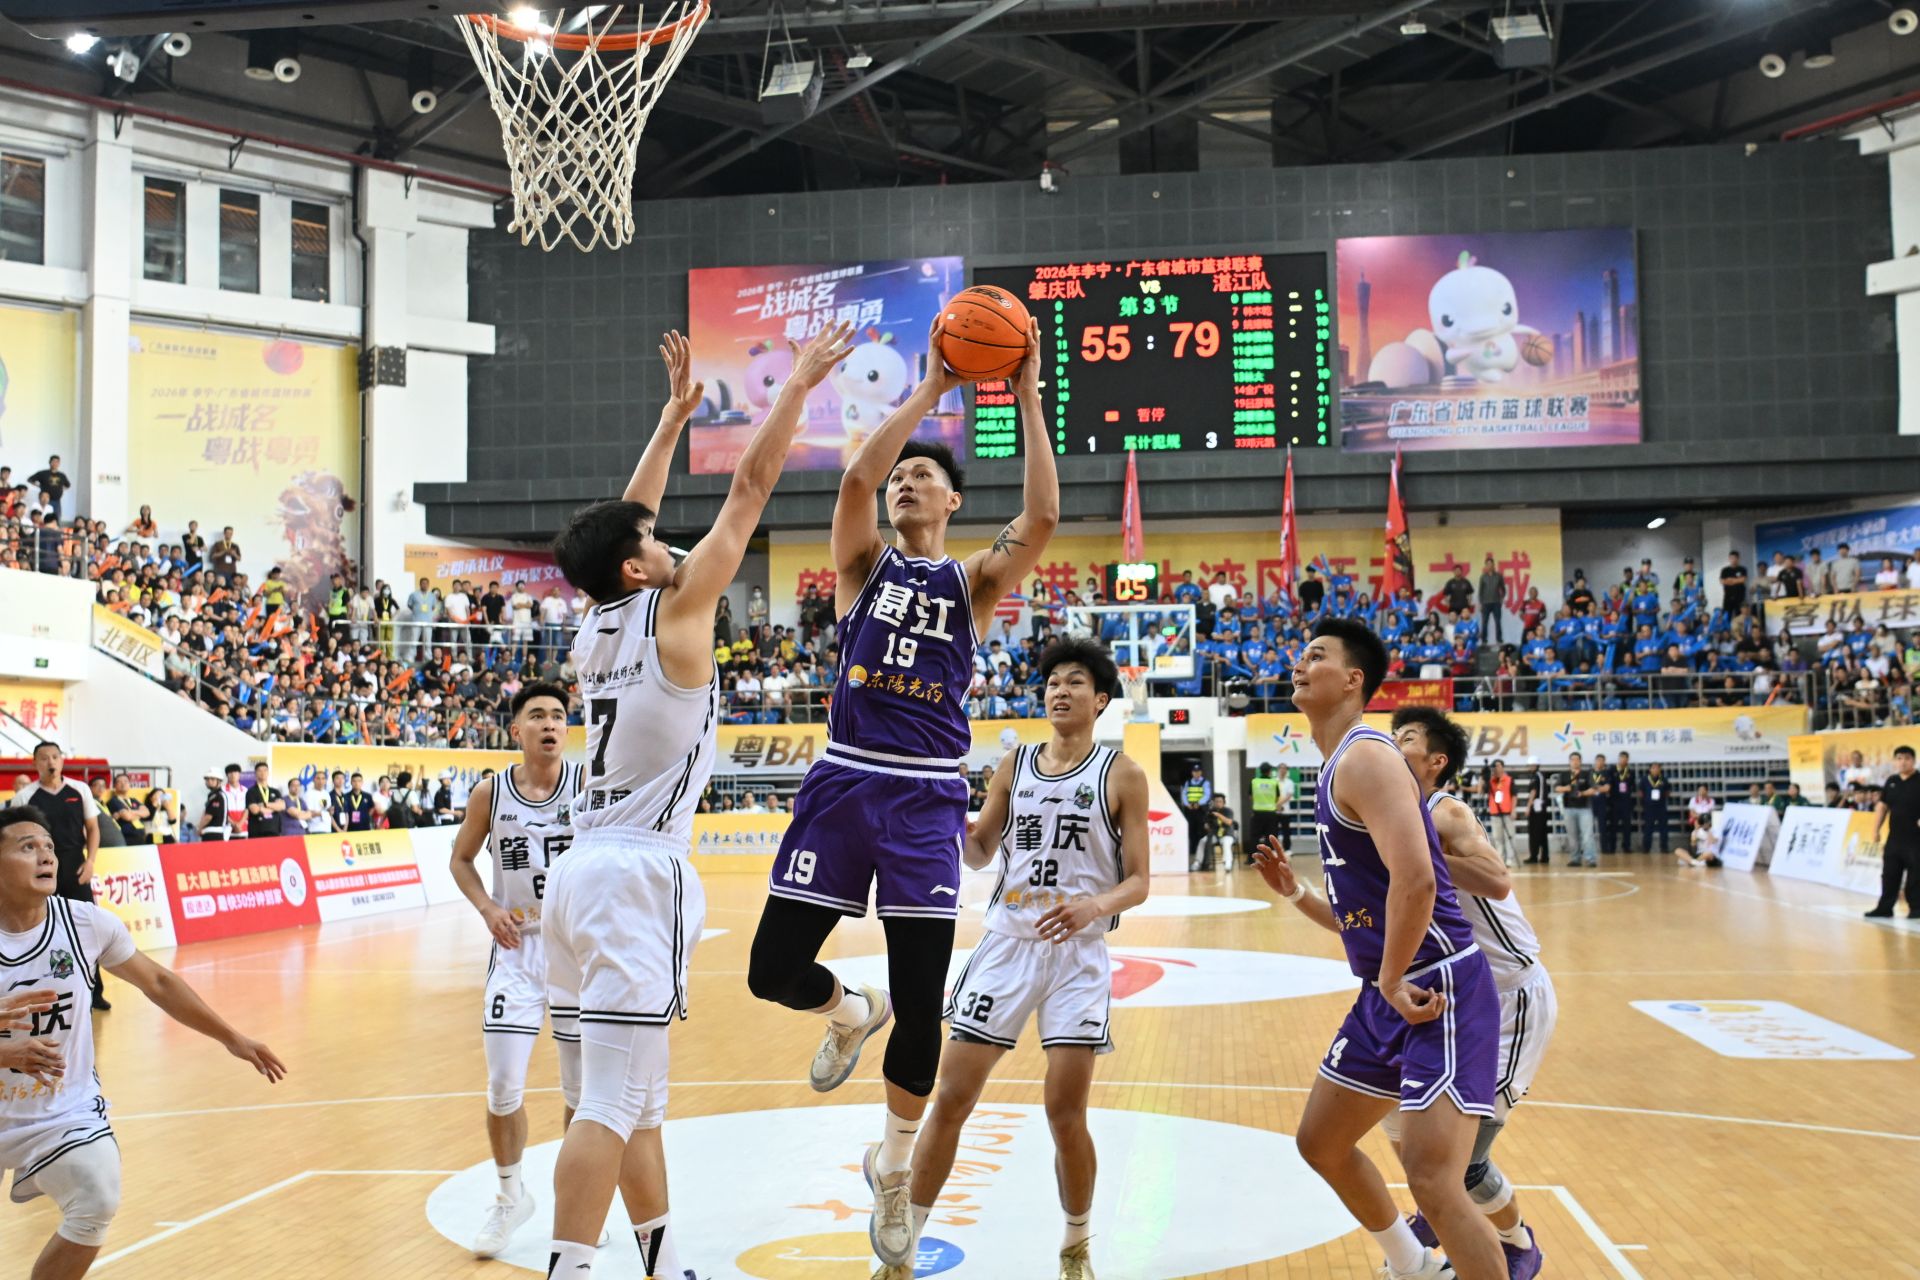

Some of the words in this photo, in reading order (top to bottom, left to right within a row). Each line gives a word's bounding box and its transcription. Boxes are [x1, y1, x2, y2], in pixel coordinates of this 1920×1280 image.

[1029, 280, 1086, 300] 肇庆队
[1212, 271, 1271, 292] 湛江队
[735, 282, 837, 320] 一战城名
[783, 298, 884, 340] 粤战粤勇
[1081, 325, 1131, 362] 55
[1169, 321, 1220, 358] 79
[155, 404, 278, 432] 一战城名
[1137, 407, 1166, 422] 暂停
[1389, 396, 1589, 424] 广东省城市篮球联赛
[1206, 432, 1217, 448] 3
[1456, 426, 1477, 434] CITY
[1481, 423, 1544, 433] BASKETBALL
[1548, 422, 1587, 432] LEAGUE
[202, 436, 320, 470] 粤战粤勇
[867, 581, 956, 642] 湛江
[883, 633, 918, 668] 19
[590, 698, 618, 776] 7
[729, 735, 815, 767] 粤BA
[1462, 725, 1529, 756] BA
[1593, 729, 1694, 745] 中国体育彩票
[1016, 813, 1090, 852] 肇庆
[1148, 826, 1174, 836] NG
[783, 849, 818, 885] 19
[1029, 859, 1059, 887] 32
[533, 874, 546, 900] 6
[492, 995, 506, 1019] 6
[961, 991, 995, 1023] 32
